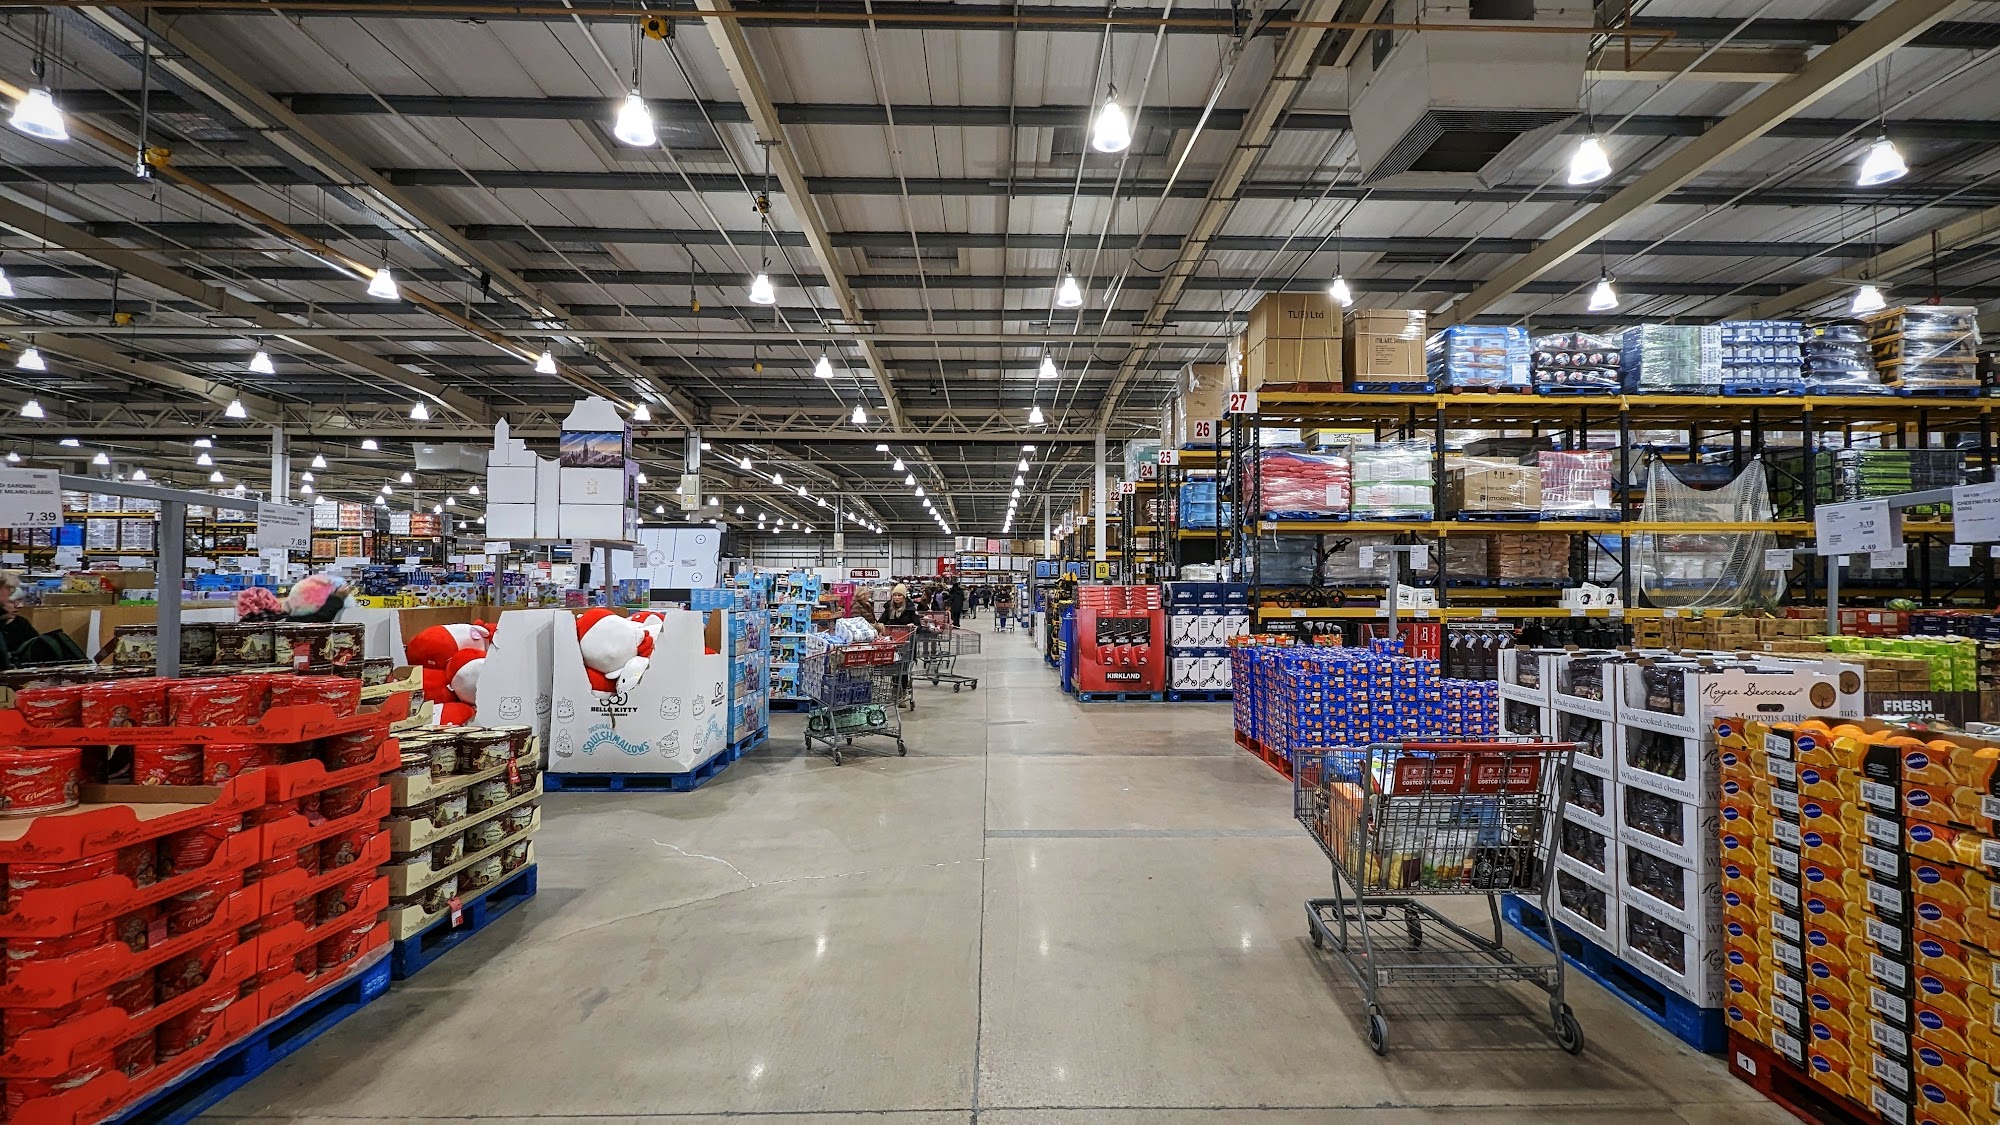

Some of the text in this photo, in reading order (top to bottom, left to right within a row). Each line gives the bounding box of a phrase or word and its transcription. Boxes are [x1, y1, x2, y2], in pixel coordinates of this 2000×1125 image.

[1310, 310, 1324, 319] Ltd
[1230, 394, 1248, 411] 27
[1196, 422, 1210, 437] 26
[1160, 452, 1171, 463] 25
[1141, 465, 1152, 476] 24
[1123, 483, 1133, 493] 23
[1110, 491, 1119, 501] 22
[26, 512, 56, 522] 7.39
[1859, 520, 1875, 528] 3.19
[1098, 566, 1106, 574] 10
[1702, 682, 1740, 704] Roger
[1553, 698, 1611, 716] Whole cooked chestnuts
[1883, 700, 1932, 712] FRESH
[1619, 712, 1695, 733] Whole cooked chestnuts
[1735, 712, 1807, 722] Marrons cuits
[588, 723, 611, 733] ORIGINAL
[582, 730, 651, 754] SQUISHMALLOWS
[1620, 771, 1640, 782] Whole
[1641, 777, 1662, 789] cooked
[1664, 783, 1695, 799] chestnuts
[1620, 829, 1694, 865] Whole cooked chestnuts
[1621, 889, 1640, 904] Whole
[1641, 901, 1663, 916] cooked
[1664, 912, 1695, 932] chestnuts
[1743, 1059, 1749, 1069] 1
